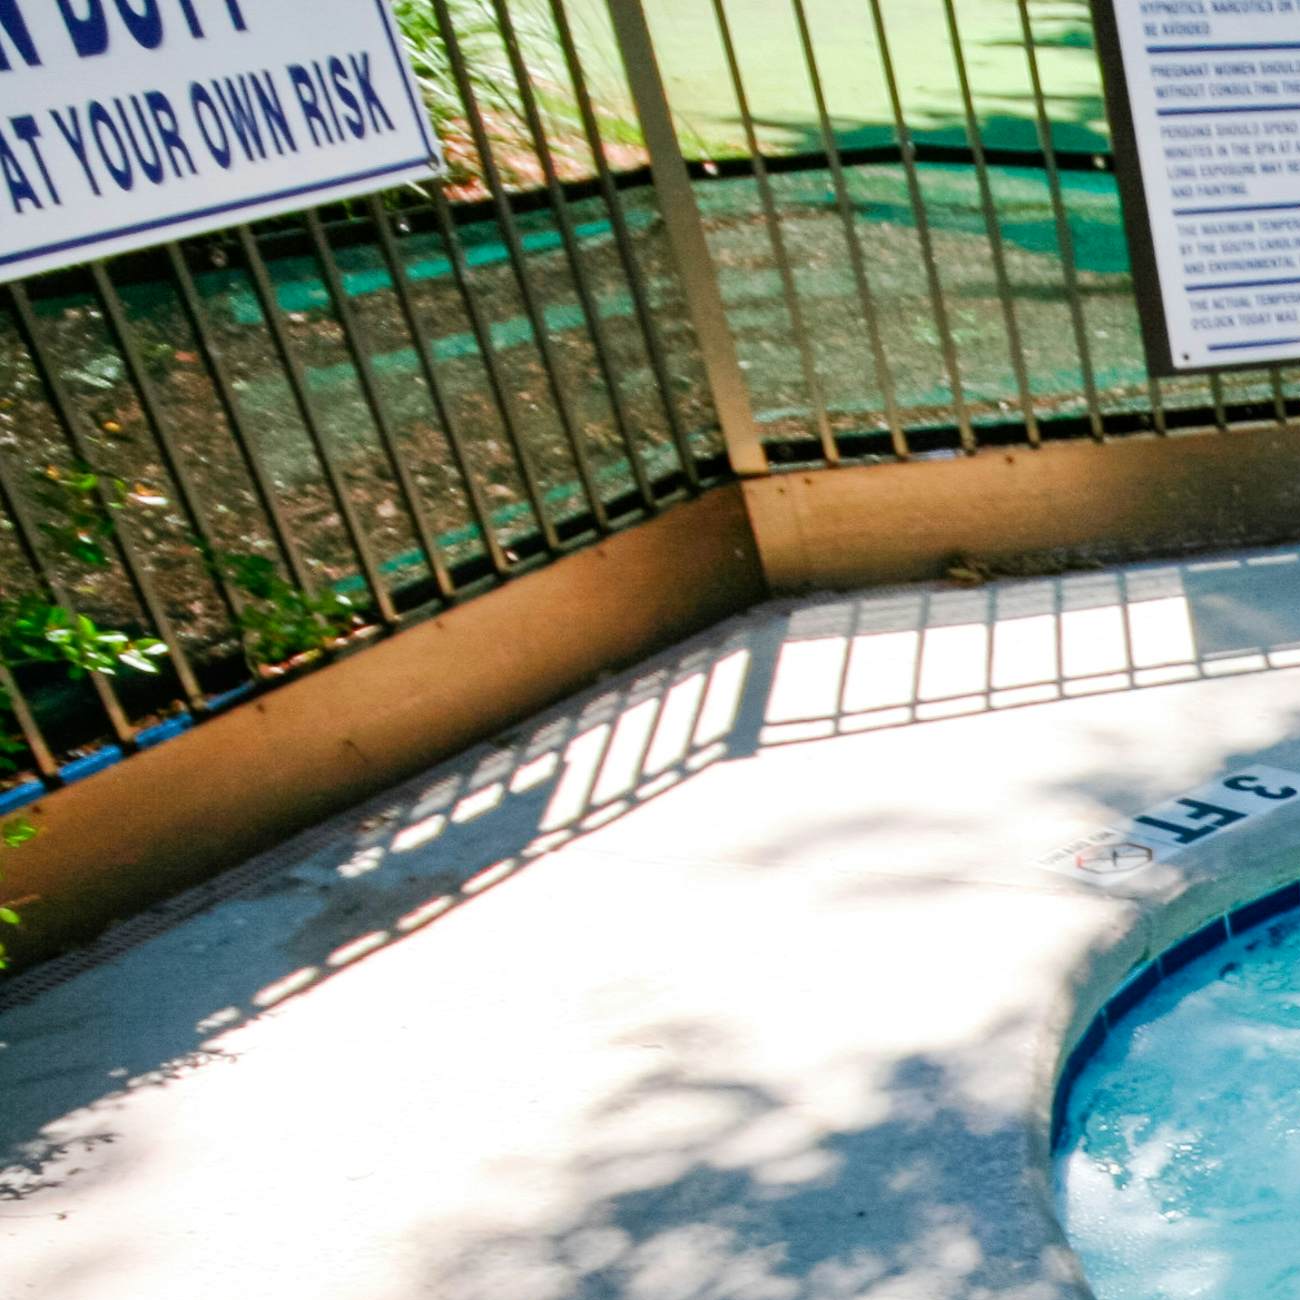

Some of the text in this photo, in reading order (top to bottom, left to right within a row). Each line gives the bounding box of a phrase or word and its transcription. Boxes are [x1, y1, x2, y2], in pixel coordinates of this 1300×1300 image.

[0, 52, 395, 214] AT YOUR OWN RISK
[1133, 775, 1297, 844] 3 FT
